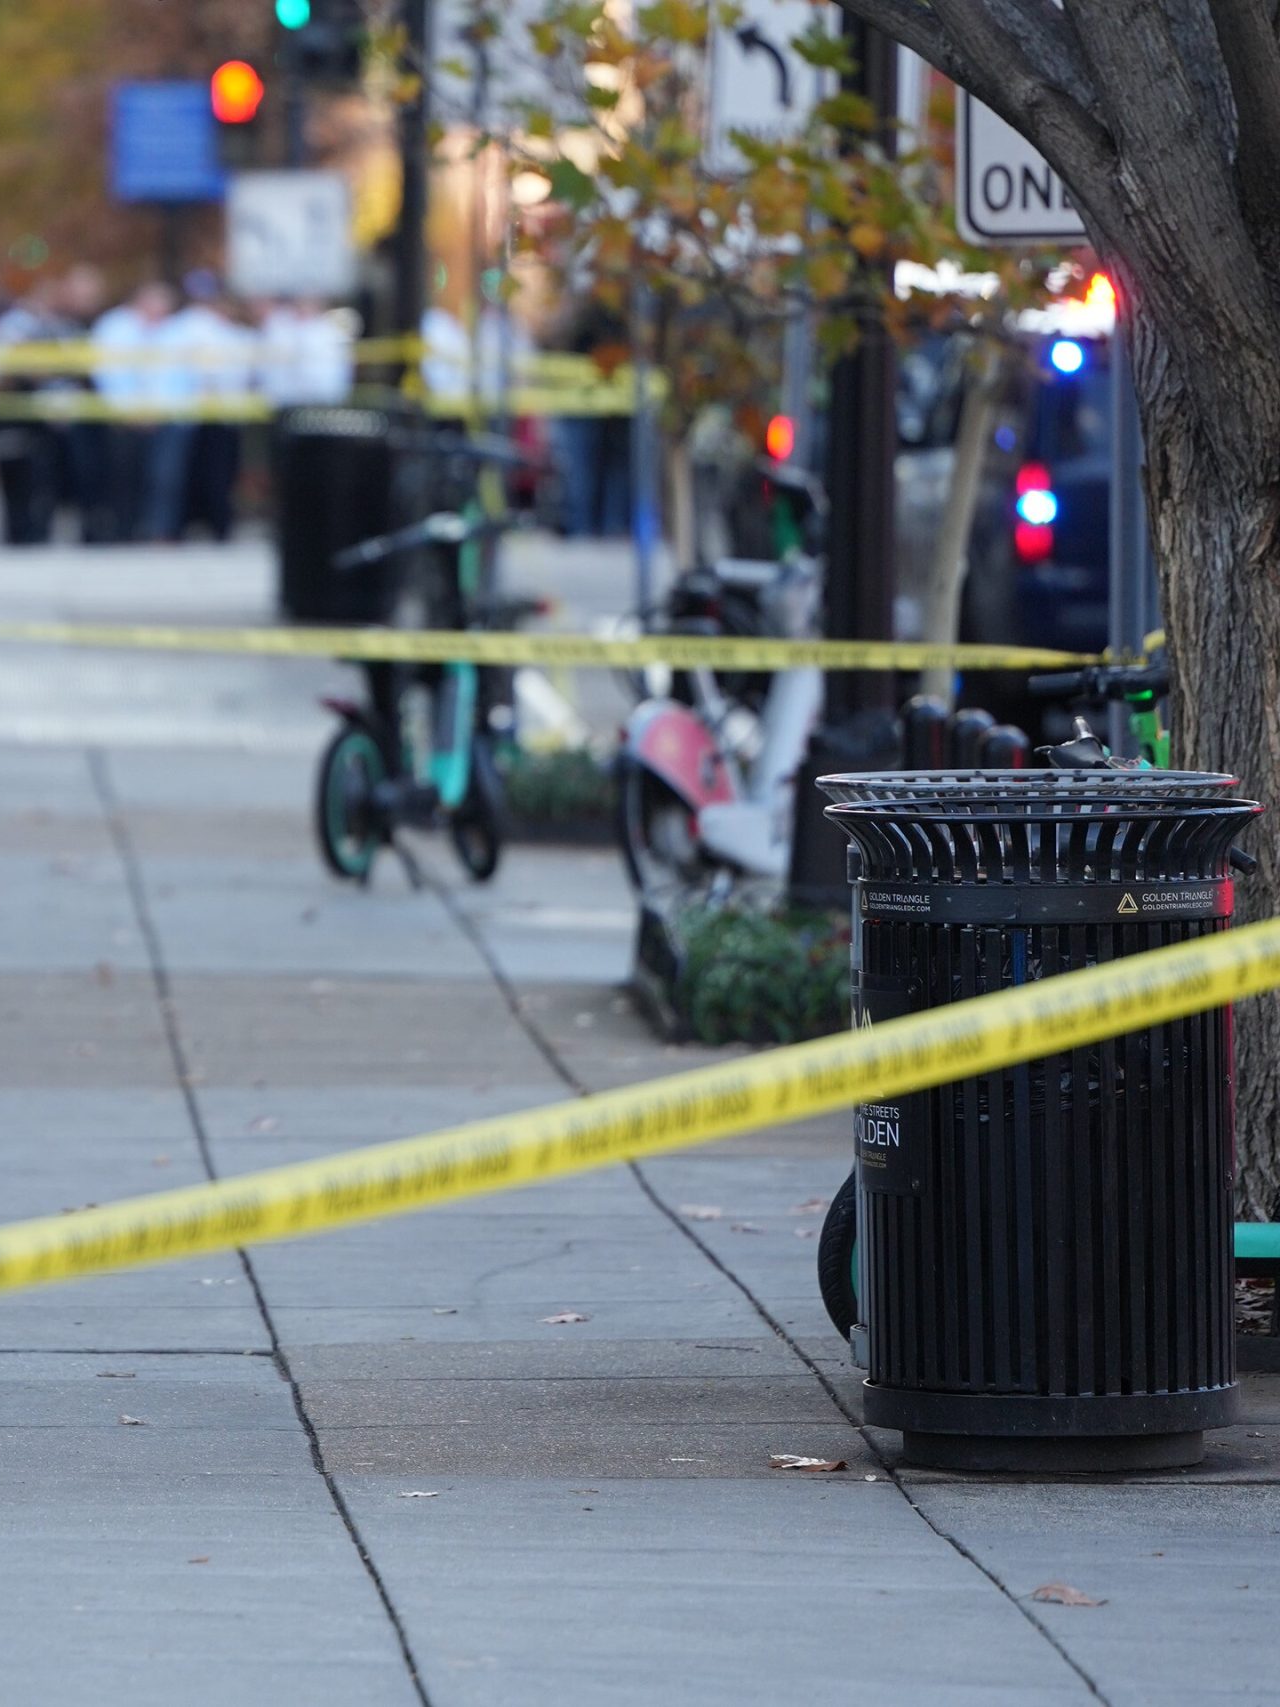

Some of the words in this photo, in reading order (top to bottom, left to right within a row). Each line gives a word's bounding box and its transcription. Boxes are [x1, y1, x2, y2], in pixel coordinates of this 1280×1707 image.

[868, 892, 891, 902] GOLDEN
[891, 893, 930, 904] TRIANGLE
[1142, 892, 1179, 902] GOLDEN
[1180, 890, 1213, 901] TRIANGLE
[869, 1105, 900, 1119] STREETS
